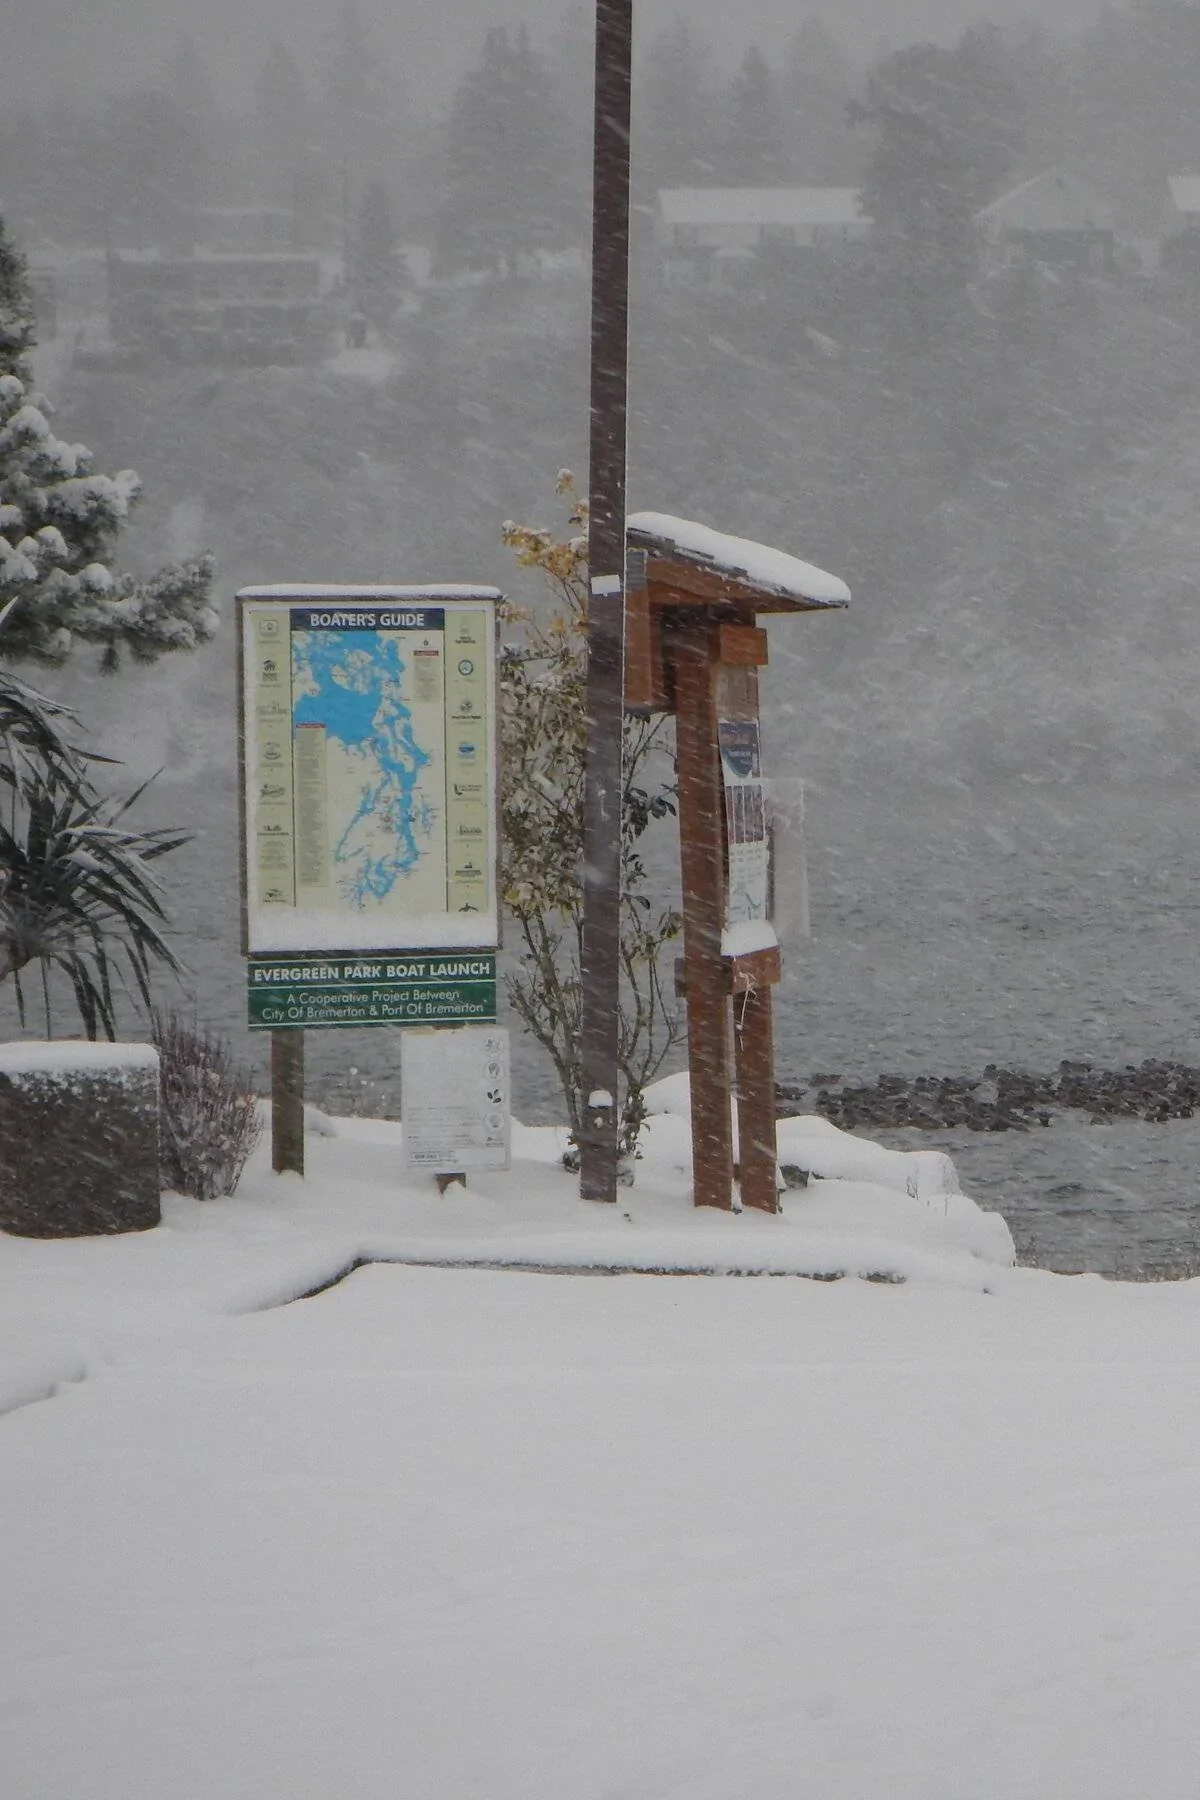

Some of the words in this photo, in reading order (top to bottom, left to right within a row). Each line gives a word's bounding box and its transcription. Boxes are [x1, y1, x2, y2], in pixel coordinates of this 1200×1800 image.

[310, 613, 376, 626] BOATER'S
[380, 613, 425, 626] GUIDE
[254, 966, 339, 981] EVERGREEN
[344, 966, 381, 979] PARK
[386, 964, 425, 977] BOAT
[430, 962, 490, 975] LAUNCH
[286, 993, 295, 1004] A
[299, 991, 369, 1006] Cooperative
[372, 990, 410, 1003] Project
[413, 989, 460, 1001] Between
[262, 1007, 284, 1020] City
[287, 1006, 304, 1018] Of
[307, 1005, 365, 1018] Bremerton
[369, 1004, 378, 1016] &
[382, 1003, 403, 1015] Port
[406, 1002, 422, 1014] Of
[425, 1002, 484, 1014] Bremerton
